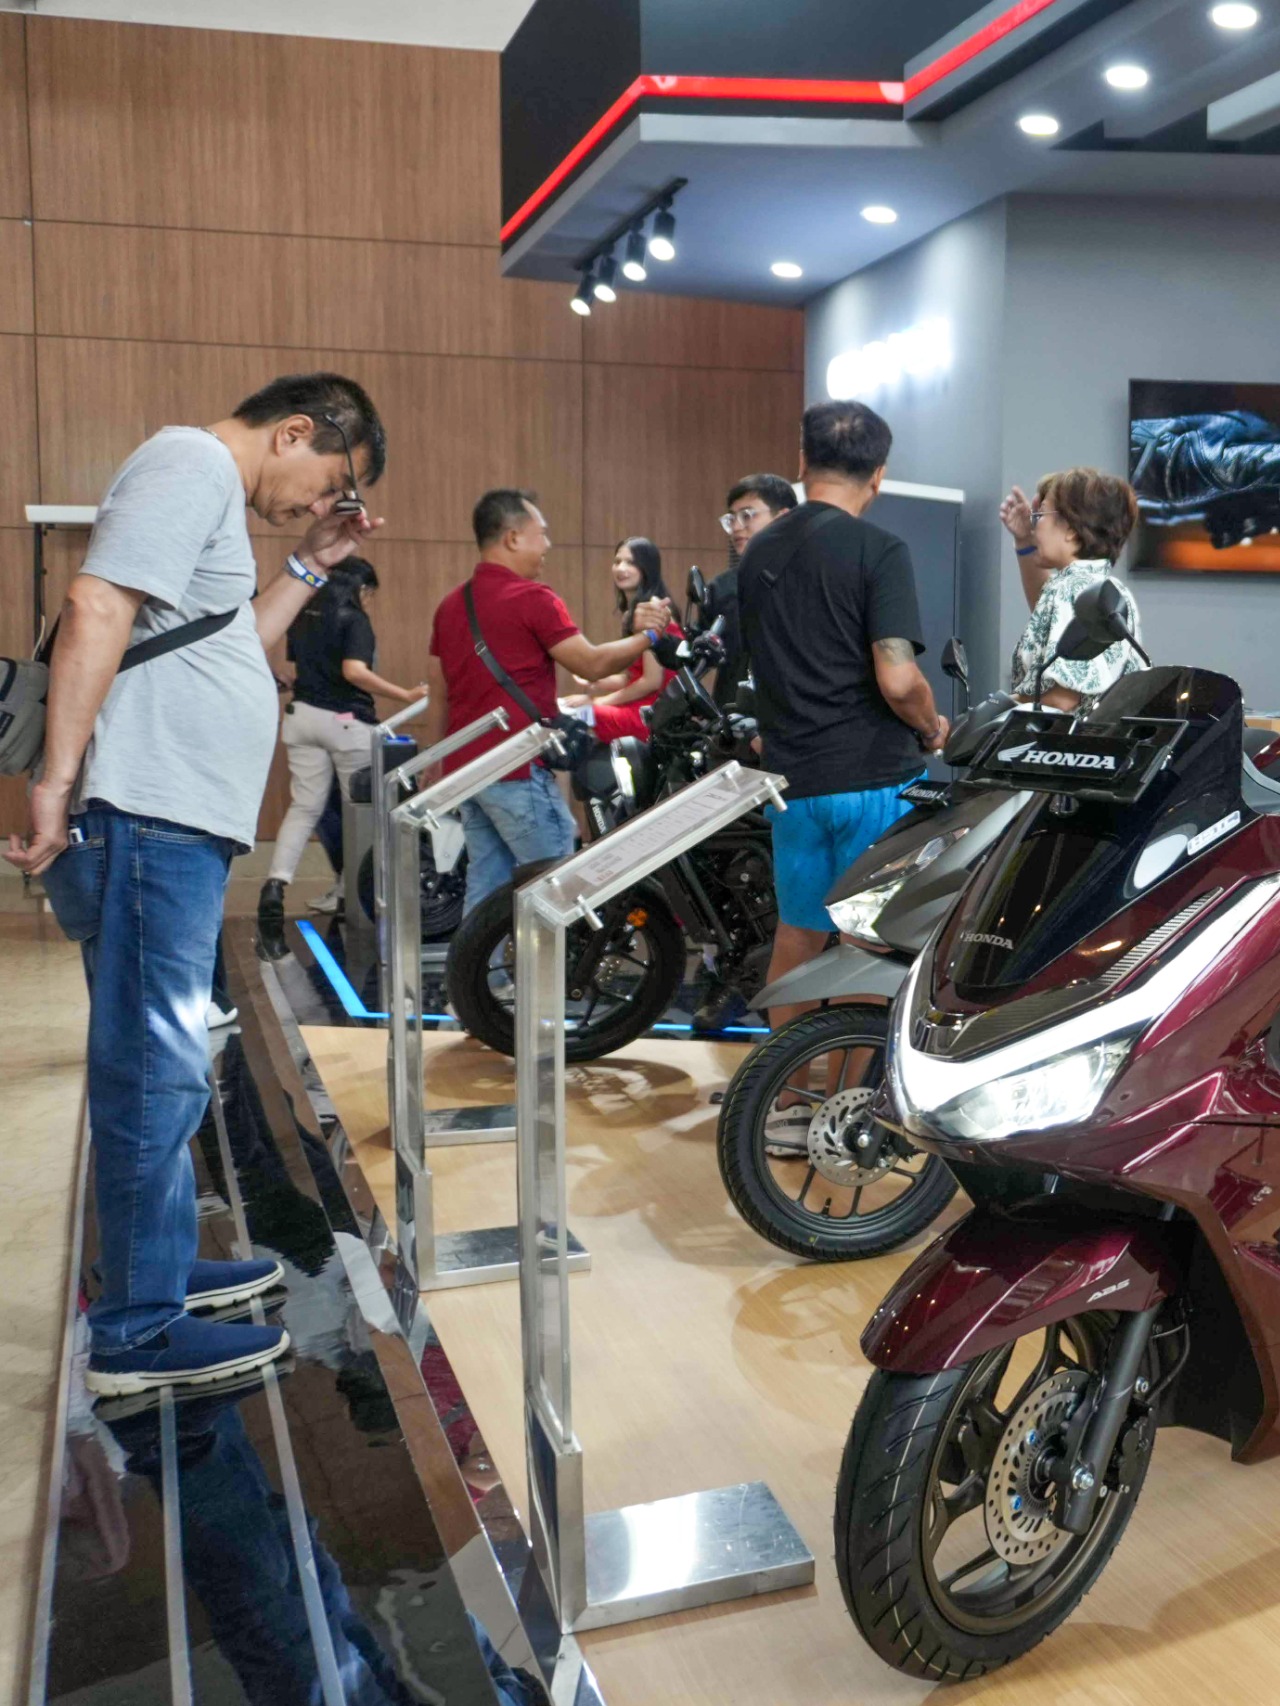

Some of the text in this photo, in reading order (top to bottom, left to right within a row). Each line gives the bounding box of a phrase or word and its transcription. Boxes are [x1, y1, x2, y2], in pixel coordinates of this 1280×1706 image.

[1020, 750, 1116, 770] HONDA
[906, 787, 938, 799] HONDA
[592, 803, 607, 835] HONDA
[963, 932, 1014, 950] HONDA
[1086, 1278, 1130, 1304] ABS
